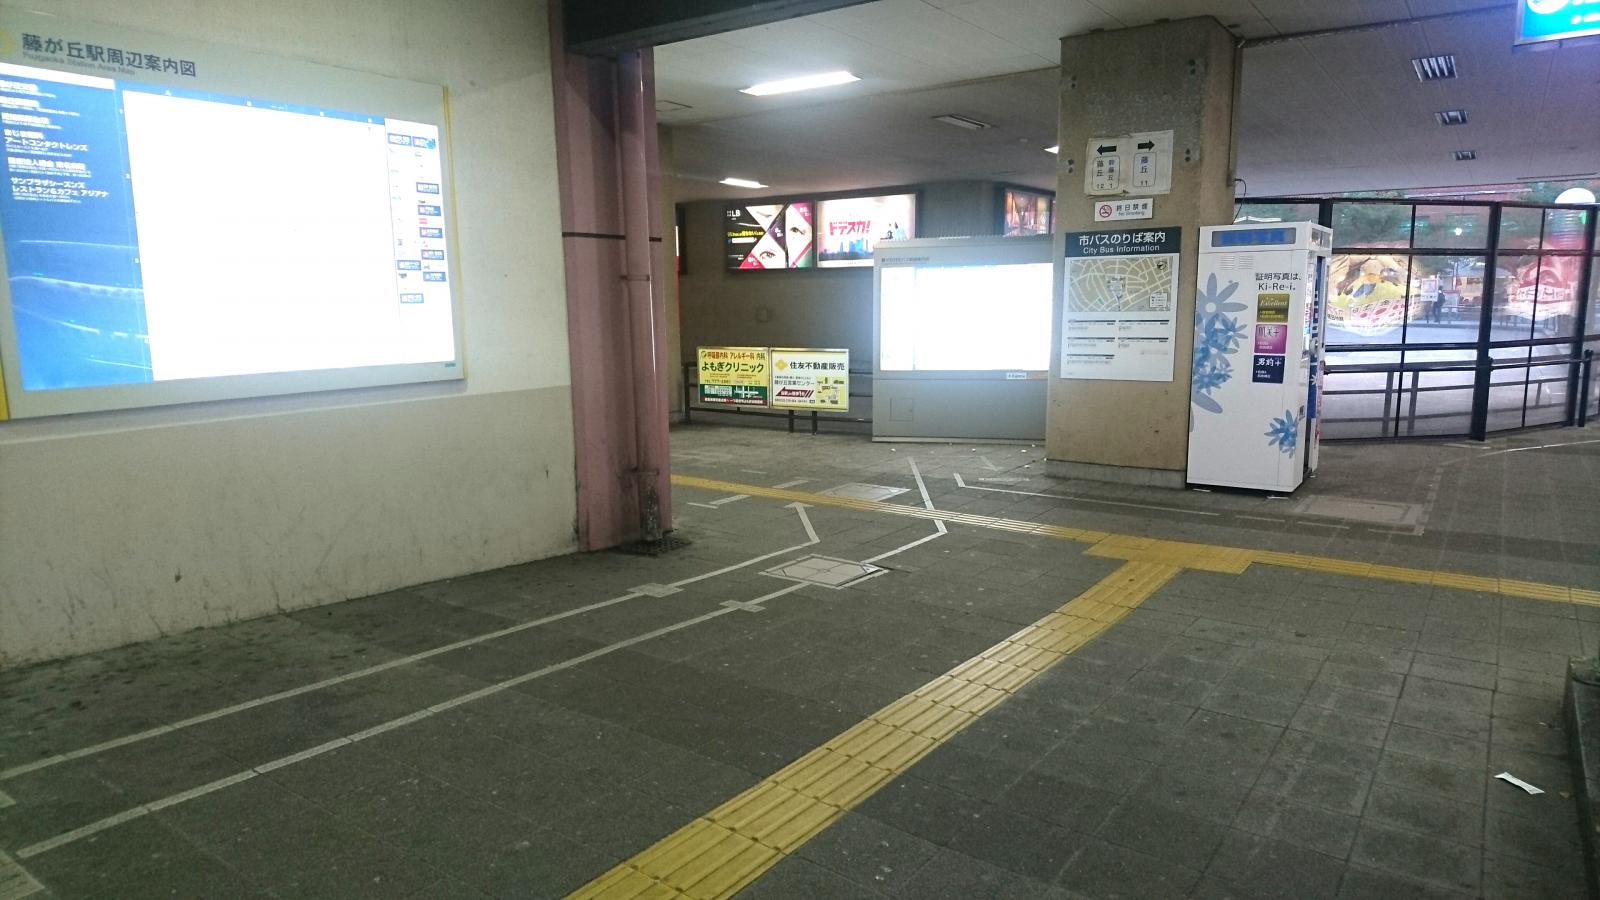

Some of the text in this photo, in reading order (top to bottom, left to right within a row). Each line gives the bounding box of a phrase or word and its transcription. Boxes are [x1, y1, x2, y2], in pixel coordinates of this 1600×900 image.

[22, 33, 196, 77] 藤が丘駅周辺案内図
[1078, 231, 1166, 246] 市バスのりば案内
[1083, 243, 1160, 255] City Bus Information
[1255, 272, 1302, 281] 証明写真は、
[1258, 282, 1296, 291] Ki-Re-i.
[756, 352, 766, 360] 内科
[701, 361, 764, 373] よもぎクリニック
[789, 361, 845, 371] 住友不動産販売
